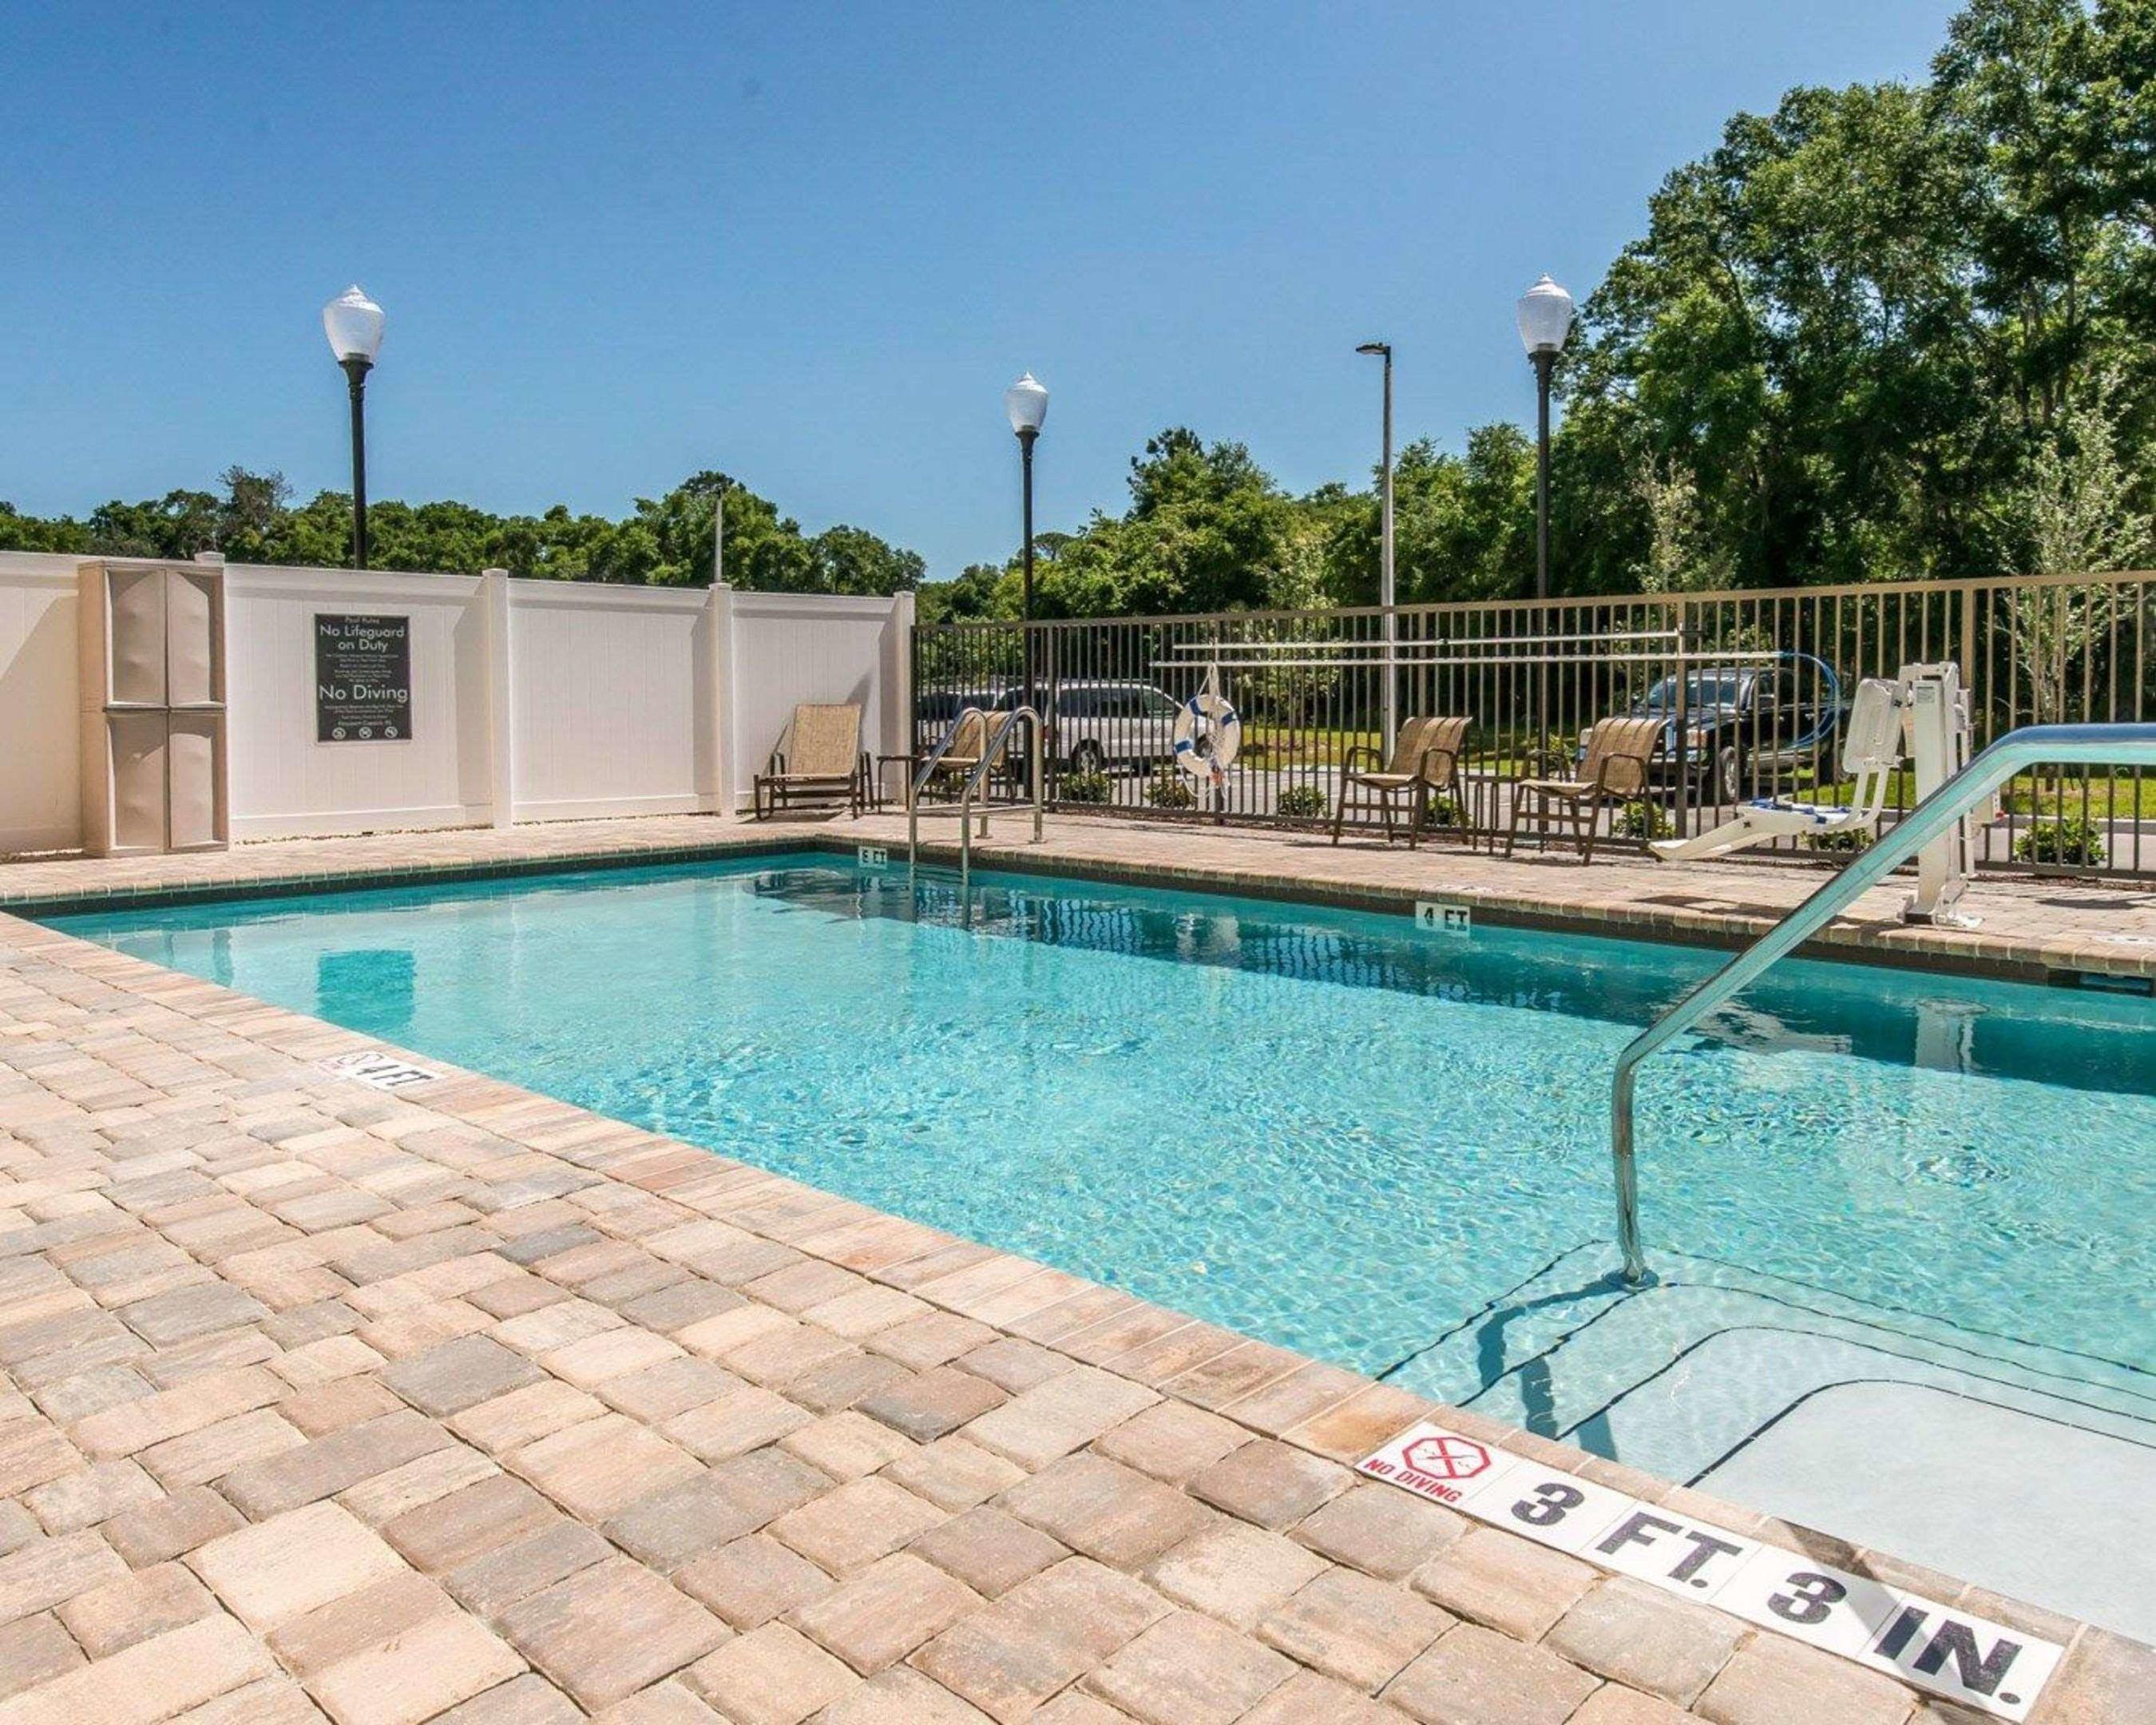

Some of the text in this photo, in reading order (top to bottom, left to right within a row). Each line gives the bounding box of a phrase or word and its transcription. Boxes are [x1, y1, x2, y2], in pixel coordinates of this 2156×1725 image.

[319, 624, 405, 640] No Lifeguard
[338, 638, 389, 653] on Duty
[319, 684, 408, 704] No Diving
[1444, 909, 1468, 931] FT
[1363, 1458, 1463, 1502] NO DIVING
[1511, 1482, 2023, 1705] 3 FT. 3 IN.
